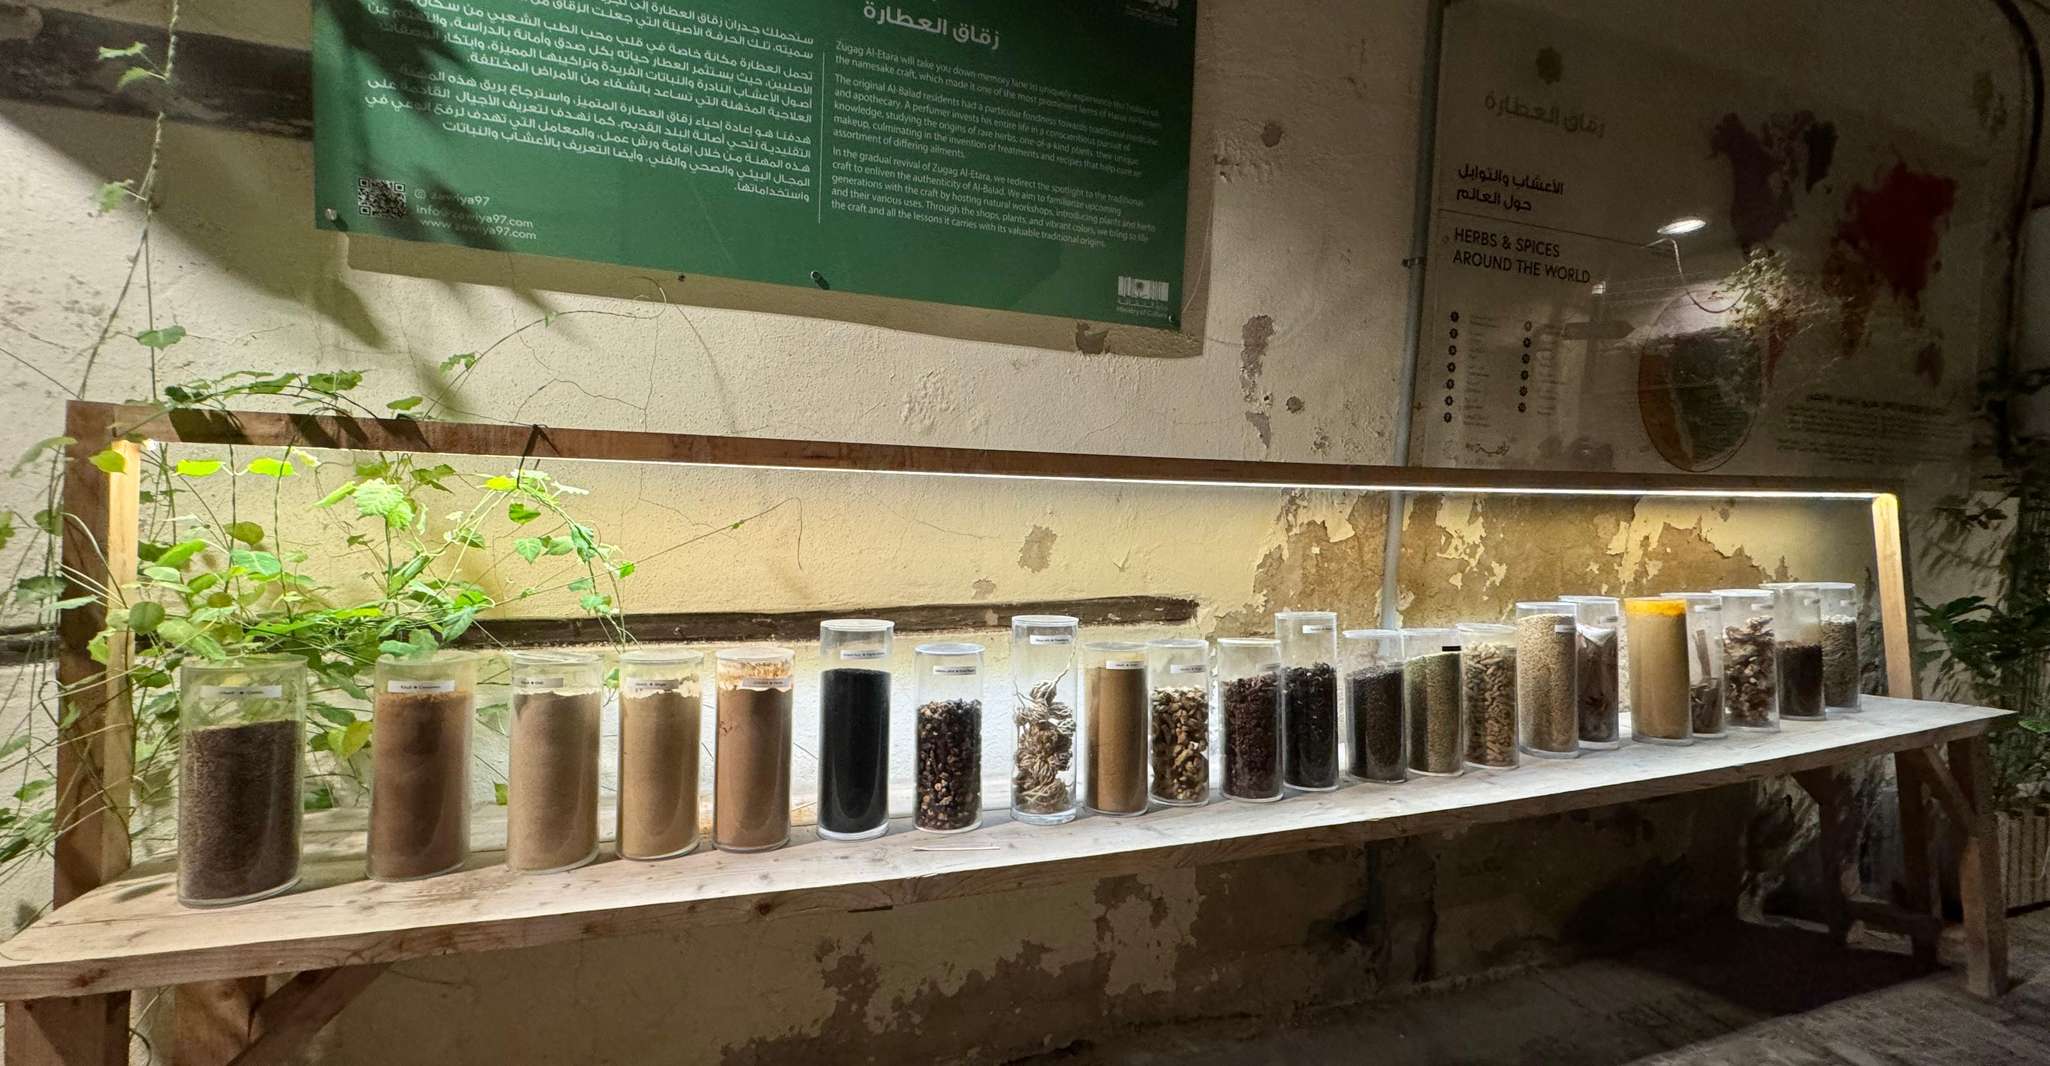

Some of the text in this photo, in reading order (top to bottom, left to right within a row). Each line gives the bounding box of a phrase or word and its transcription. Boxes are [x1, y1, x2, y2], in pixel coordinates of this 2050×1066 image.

[366, 0, 389, 16] عن
[462, 1, 483, 17] من
[551, 0, 589, 14] الزقاق
[591, 5, 633, 24] جعلت
[650, 0, 694, 19] العطارة
[486, 11, 540, 27] الشعبي
[635, 16, 659, 29] التي
[697, 12, 722, 27] زقاق
[724, 18, 760, 34] جدران
[863, 0, 1001, 51] زقاق العطارة
[543, 20, 577, 34] الطب
[662, 20, 702, 36] الأصيلة
[443, 31, 484, 50] وابتكار
[513, 28, 551, 46] وأمانة
[580, 28, 613, 42] محب
[615, 35, 643, 47] قلب
[704, 28, 744, 45] الحرفة
[761, 27, 813, 45] ستحملك
[553, 37, 585, 51] صدق
[588, 44, 613, 59] بكل
[645, 42, 665, 54] في
[668, 42, 701, 59] خاصة
[746, 38, 770, 50] تلك
[538, 49, 598, 71] وتراكيبها
[616, 49, 649, 64] حياته
[652, 56, 688, 71] العطار
[703, 49, 736, 66] مكانة
[530, 65, 577, 81] الأمراض
[601, 60, 643, 77] الفريدة
[691, 64, 733, 81] يستثمر
[739, 57, 780, 74] العطارة
[447, 74, 476, 87] هذه
[580, 73, 599, 86] من
[645, 71, 694, 88] والنباتات
[736, 72, 762, 86] حيث
[782, 67, 812, 80] تحمل
[366, 77, 395, 90] على
[479, 78, 506, 94] بريق
[602, 78, 650, 96] بالشفاء
[696, 79, 731, 93] النادرة
[365, 93, 388, 107] في
[455, 91, 499, 106] الأجيال
[509, 83, 570, 105] واسترجاع
[653, 88, 692, 102] تساعد
[694, 95, 718, 108] التي
[733, 88, 779, 102] الأعشاب
[501, 99, 548, 114] لتعريف
[720, 98, 765, 114] المذهلة
[781, 96, 812, 108] أصول
[433, 103, 464, 117] لرفع
[466, 110, 506, 123] تهدف
[550, 108, 590, 122] نهدف
[619, 102, 664, 119] العطارة
[767, 106, 811, 123] العلاجية
[508, 117, 535, 130] التي
[593, 113, 615, 126] كما
[666, 111, 692, 125] زقاق
[695, 116, 722, 131] إحياء
[442, 122, 498, 140] والنباتات
[537, 121, 594, 139] والمعامل
[664, 127, 689, 138] البلد
[724, 120, 752, 136] إعادة
[754, 128, 773, 138] هو
[500, 131, 560, 150] بالأعشاب
[631, 134, 659, 150] ورش
[692, 130, 724, 144] أصالة
[726, 139, 758, 150] لتحي
[775, 130, 811, 144] هدفنا
[562, 140, 610, 155] التعريف
[661, 139, 692, 155] إقامة
[694, 146, 720, 158] خلال
[760, 141, 810, 158] التقليدية
[722, 152, 742, 163] من
[744, 153, 782, 168] المهنة
[688, 163, 734, 176] والصحي
[784, 162, 810, 172] هذه
[832, 161, 851, 171] craft
[853, 162, 863, 173] to
[897, 169, 911, 180] the
[773, 173, 810, 186] المجال
[832, 174, 883, 189] generations
[904, 183, 918, 194] the
[1458, 163, 1564, 195] الأعشاب والتوابل
[831, 187, 848, 197] and
[1456, 188, 1532, 212] حول العالم
[1454, 227, 1560, 258] HERBS & SPICES
[1453, 250, 1590, 284] AROUND THE WORLD
